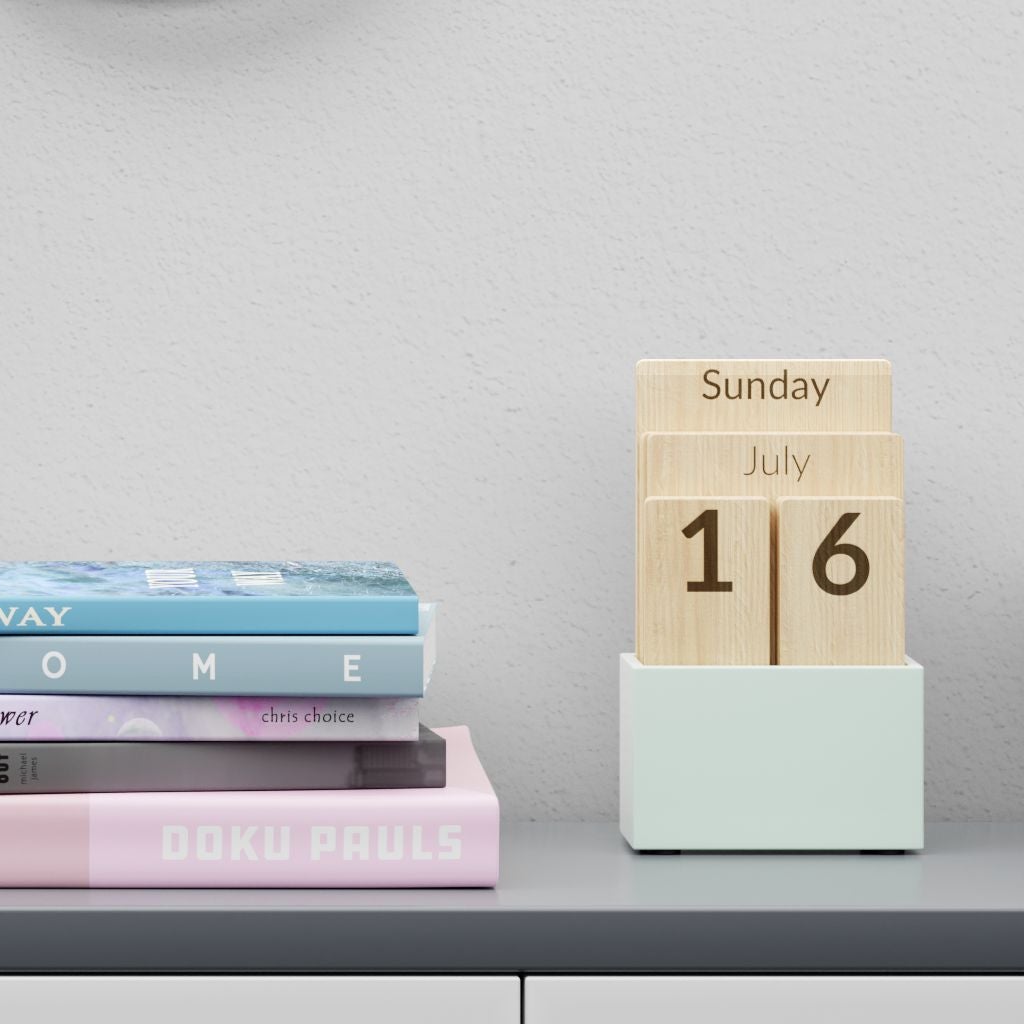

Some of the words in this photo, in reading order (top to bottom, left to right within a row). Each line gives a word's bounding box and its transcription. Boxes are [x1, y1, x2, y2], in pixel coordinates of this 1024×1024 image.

[702, 369, 830, 407] Sunday
[743, 445, 811, 482] July
[261, 706, 298, 723] chris
[304, 706, 355, 723] choice
[162, 824, 291, 862] DOKU
[310, 824, 463, 862] PAULS
